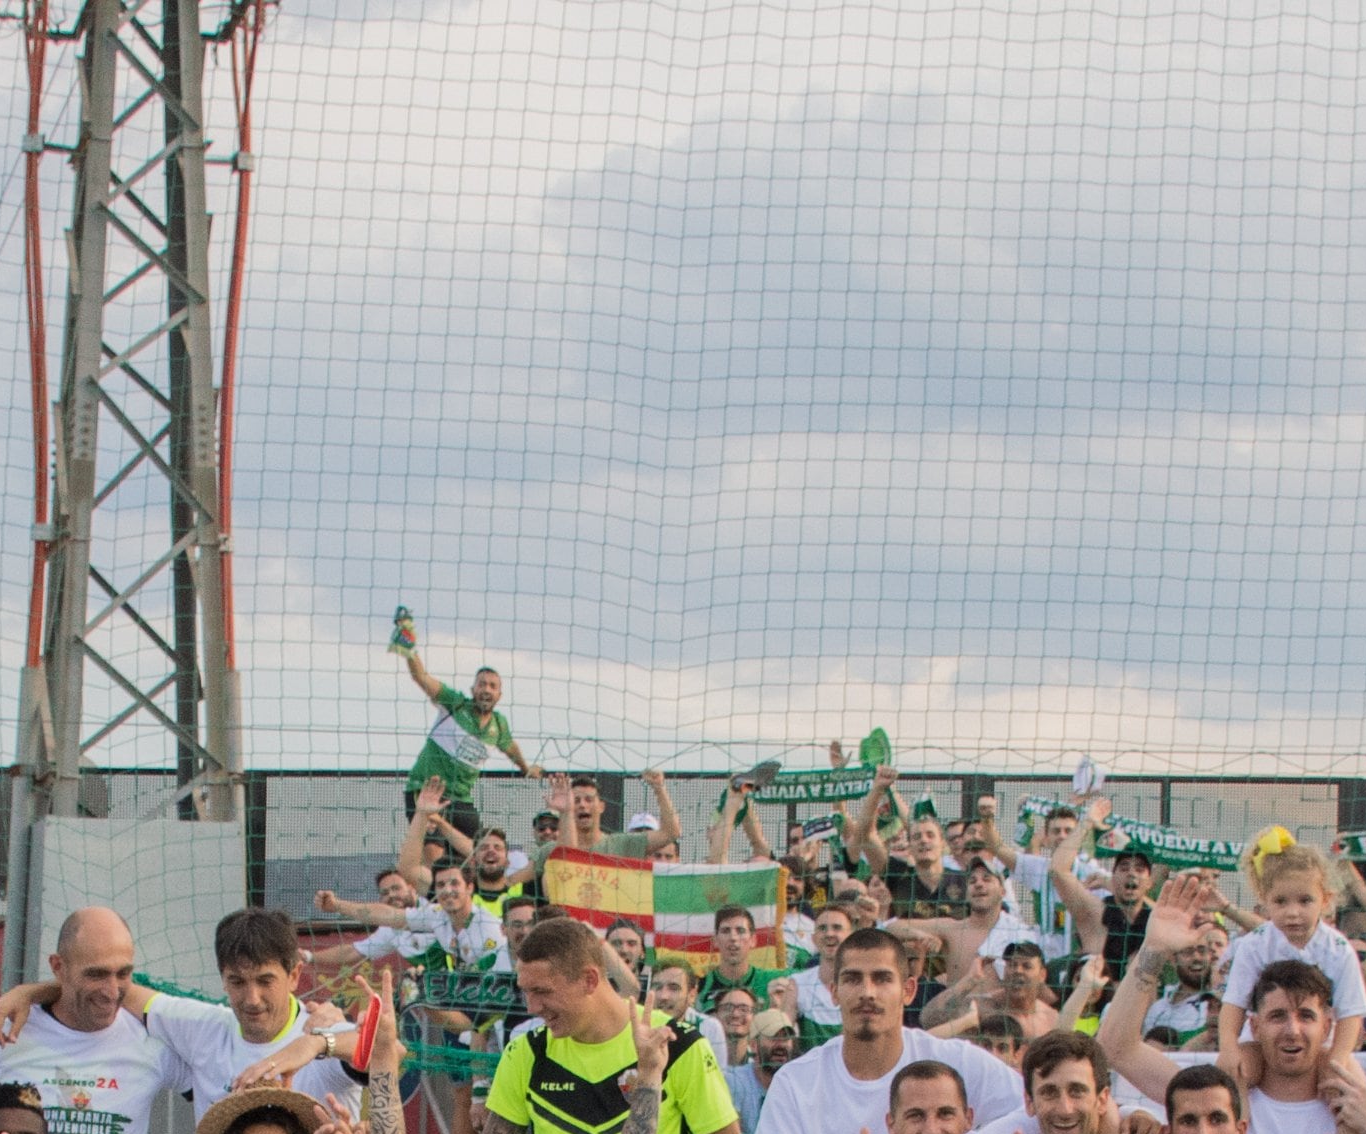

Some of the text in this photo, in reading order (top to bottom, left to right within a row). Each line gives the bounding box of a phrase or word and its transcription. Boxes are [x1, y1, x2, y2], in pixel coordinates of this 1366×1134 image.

[824, 779, 873, 797] UELVE
[427, 972, 514, 1003] Elche
[43, 1078, 120, 1091] ASCENSO 2A
[540, 1082, 576, 1092] KELME
[44, 1110, 113, 1126] UNA FRANJA
